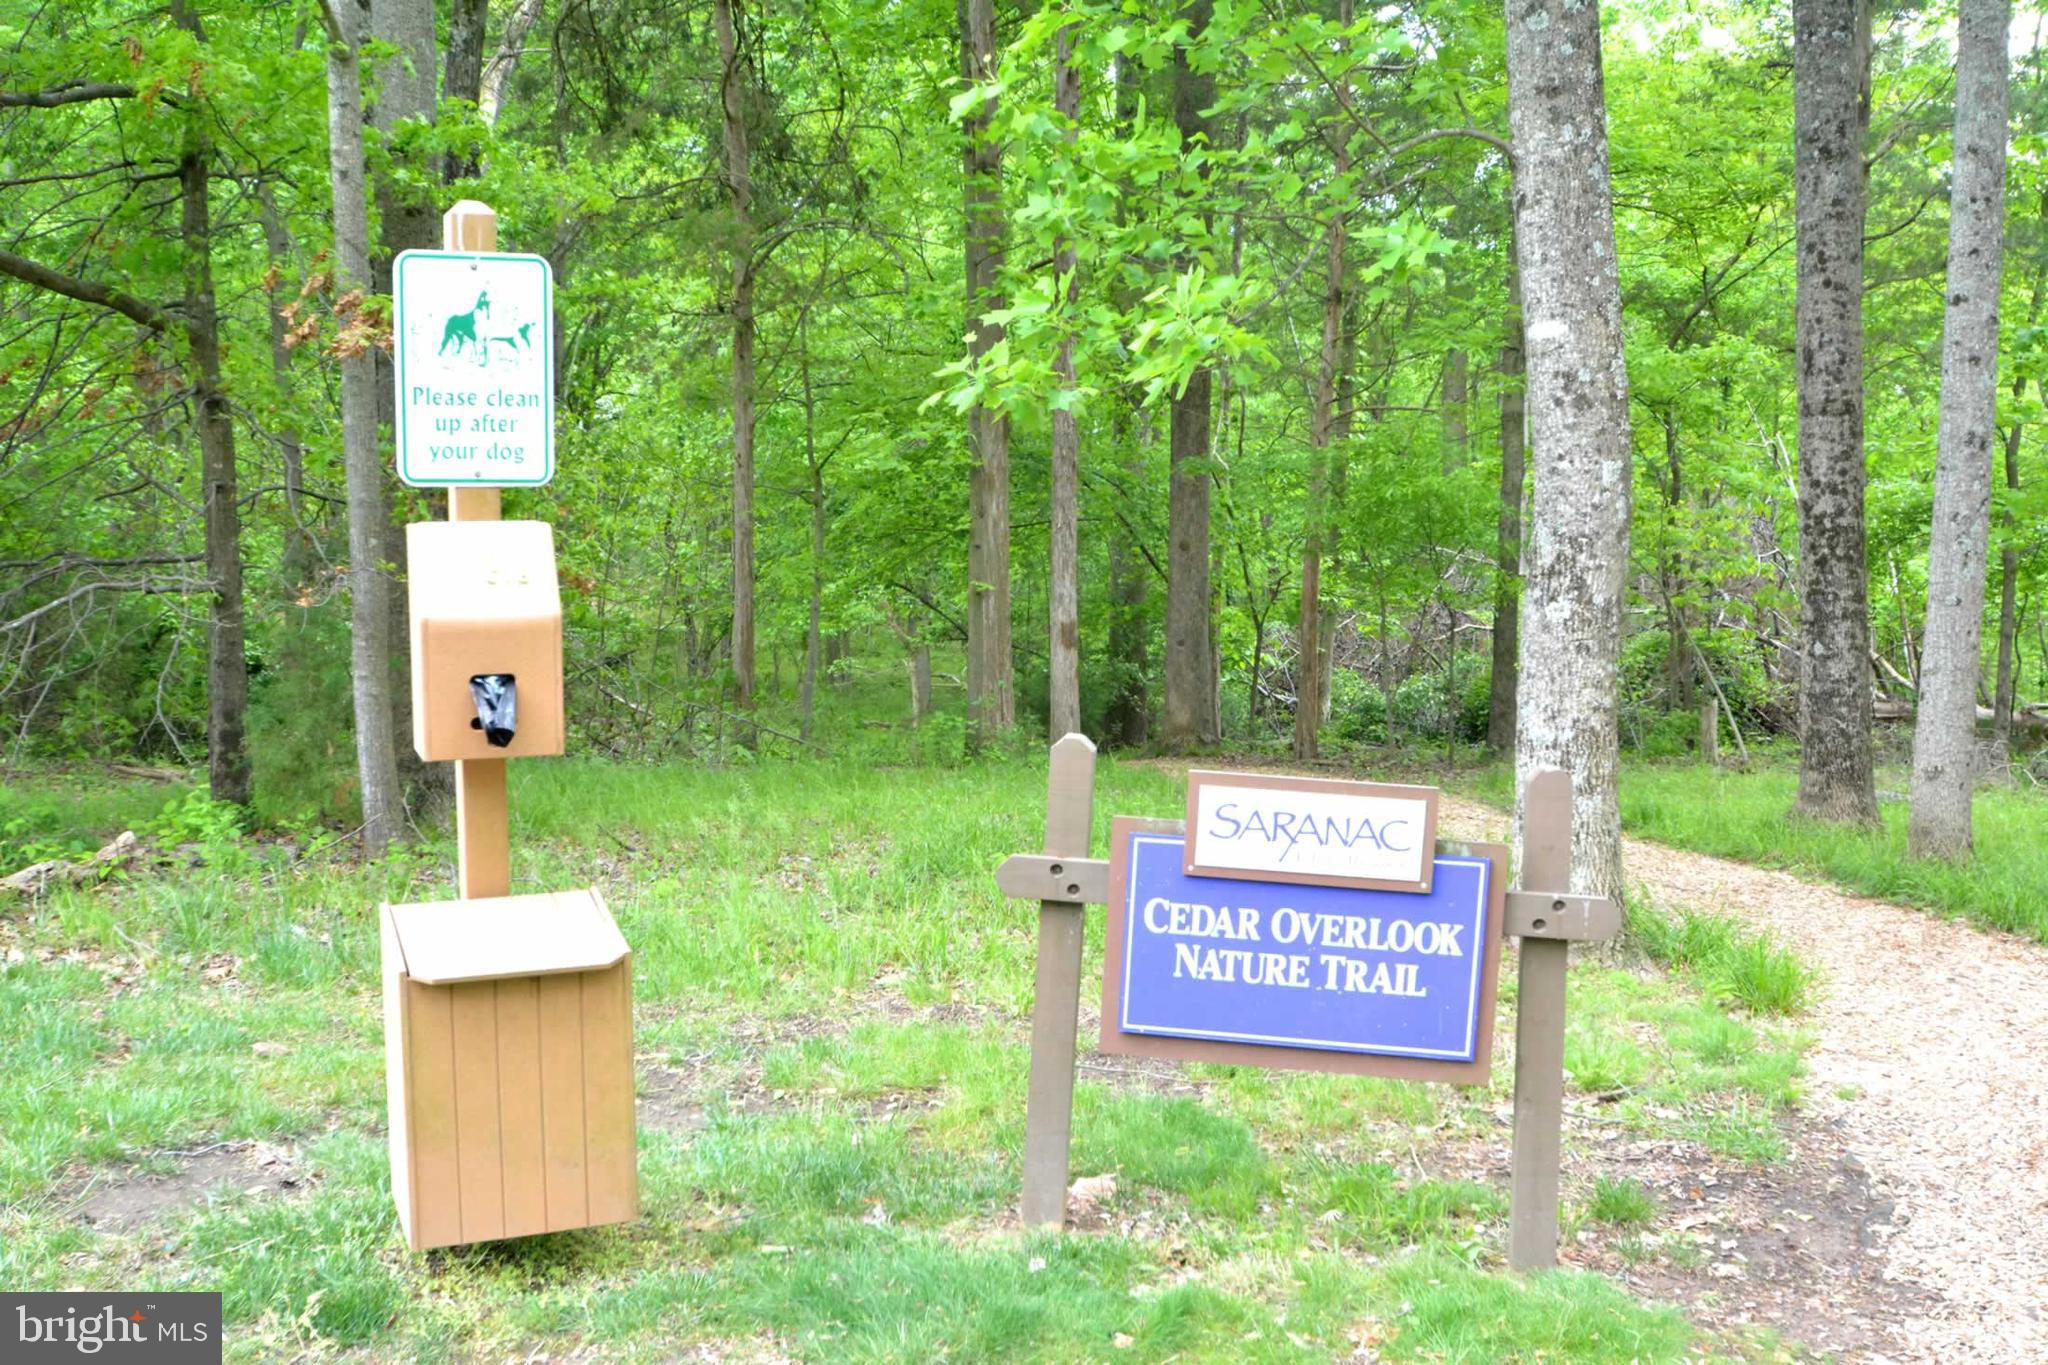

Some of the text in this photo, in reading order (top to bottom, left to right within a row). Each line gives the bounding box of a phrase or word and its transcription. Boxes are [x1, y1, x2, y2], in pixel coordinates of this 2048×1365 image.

[412, 387, 540, 408] Please clean
[435, 414, 518, 435] up after
[429, 442, 525, 465] your dog
[1208, 803, 1412, 863] SARANAC
[1143, 897, 1464, 957] CEDAR OVERLOOK
[1172, 942, 1427, 998] NATURE TRAIL
